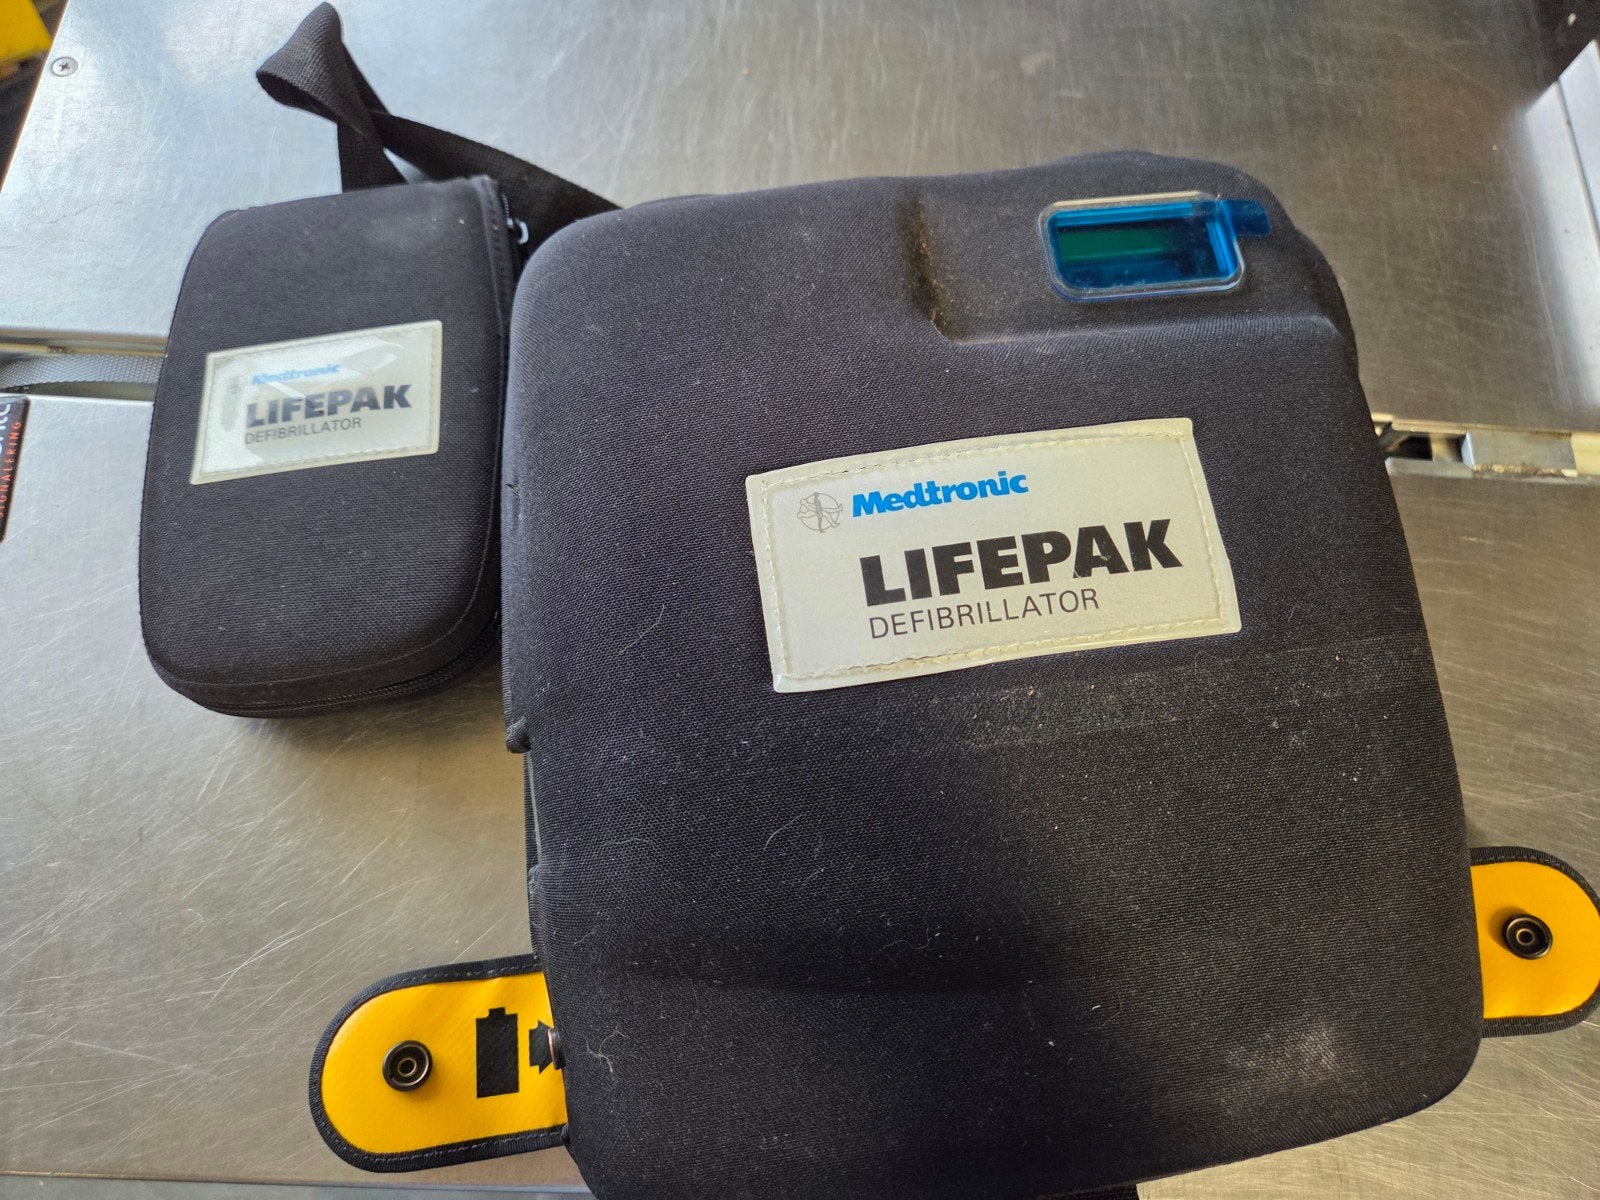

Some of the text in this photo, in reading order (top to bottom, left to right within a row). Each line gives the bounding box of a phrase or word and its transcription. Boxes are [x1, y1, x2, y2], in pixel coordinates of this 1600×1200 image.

[246, 384, 412, 427] LIFEPAK
[245, 417, 362, 445] DEFIBRILLATOR
[851, 470, 1029, 518] Medtronic
[860, 519, 1183, 607] LIFEPAK
[869, 588, 1100, 639] DEFIBRILLATOR
